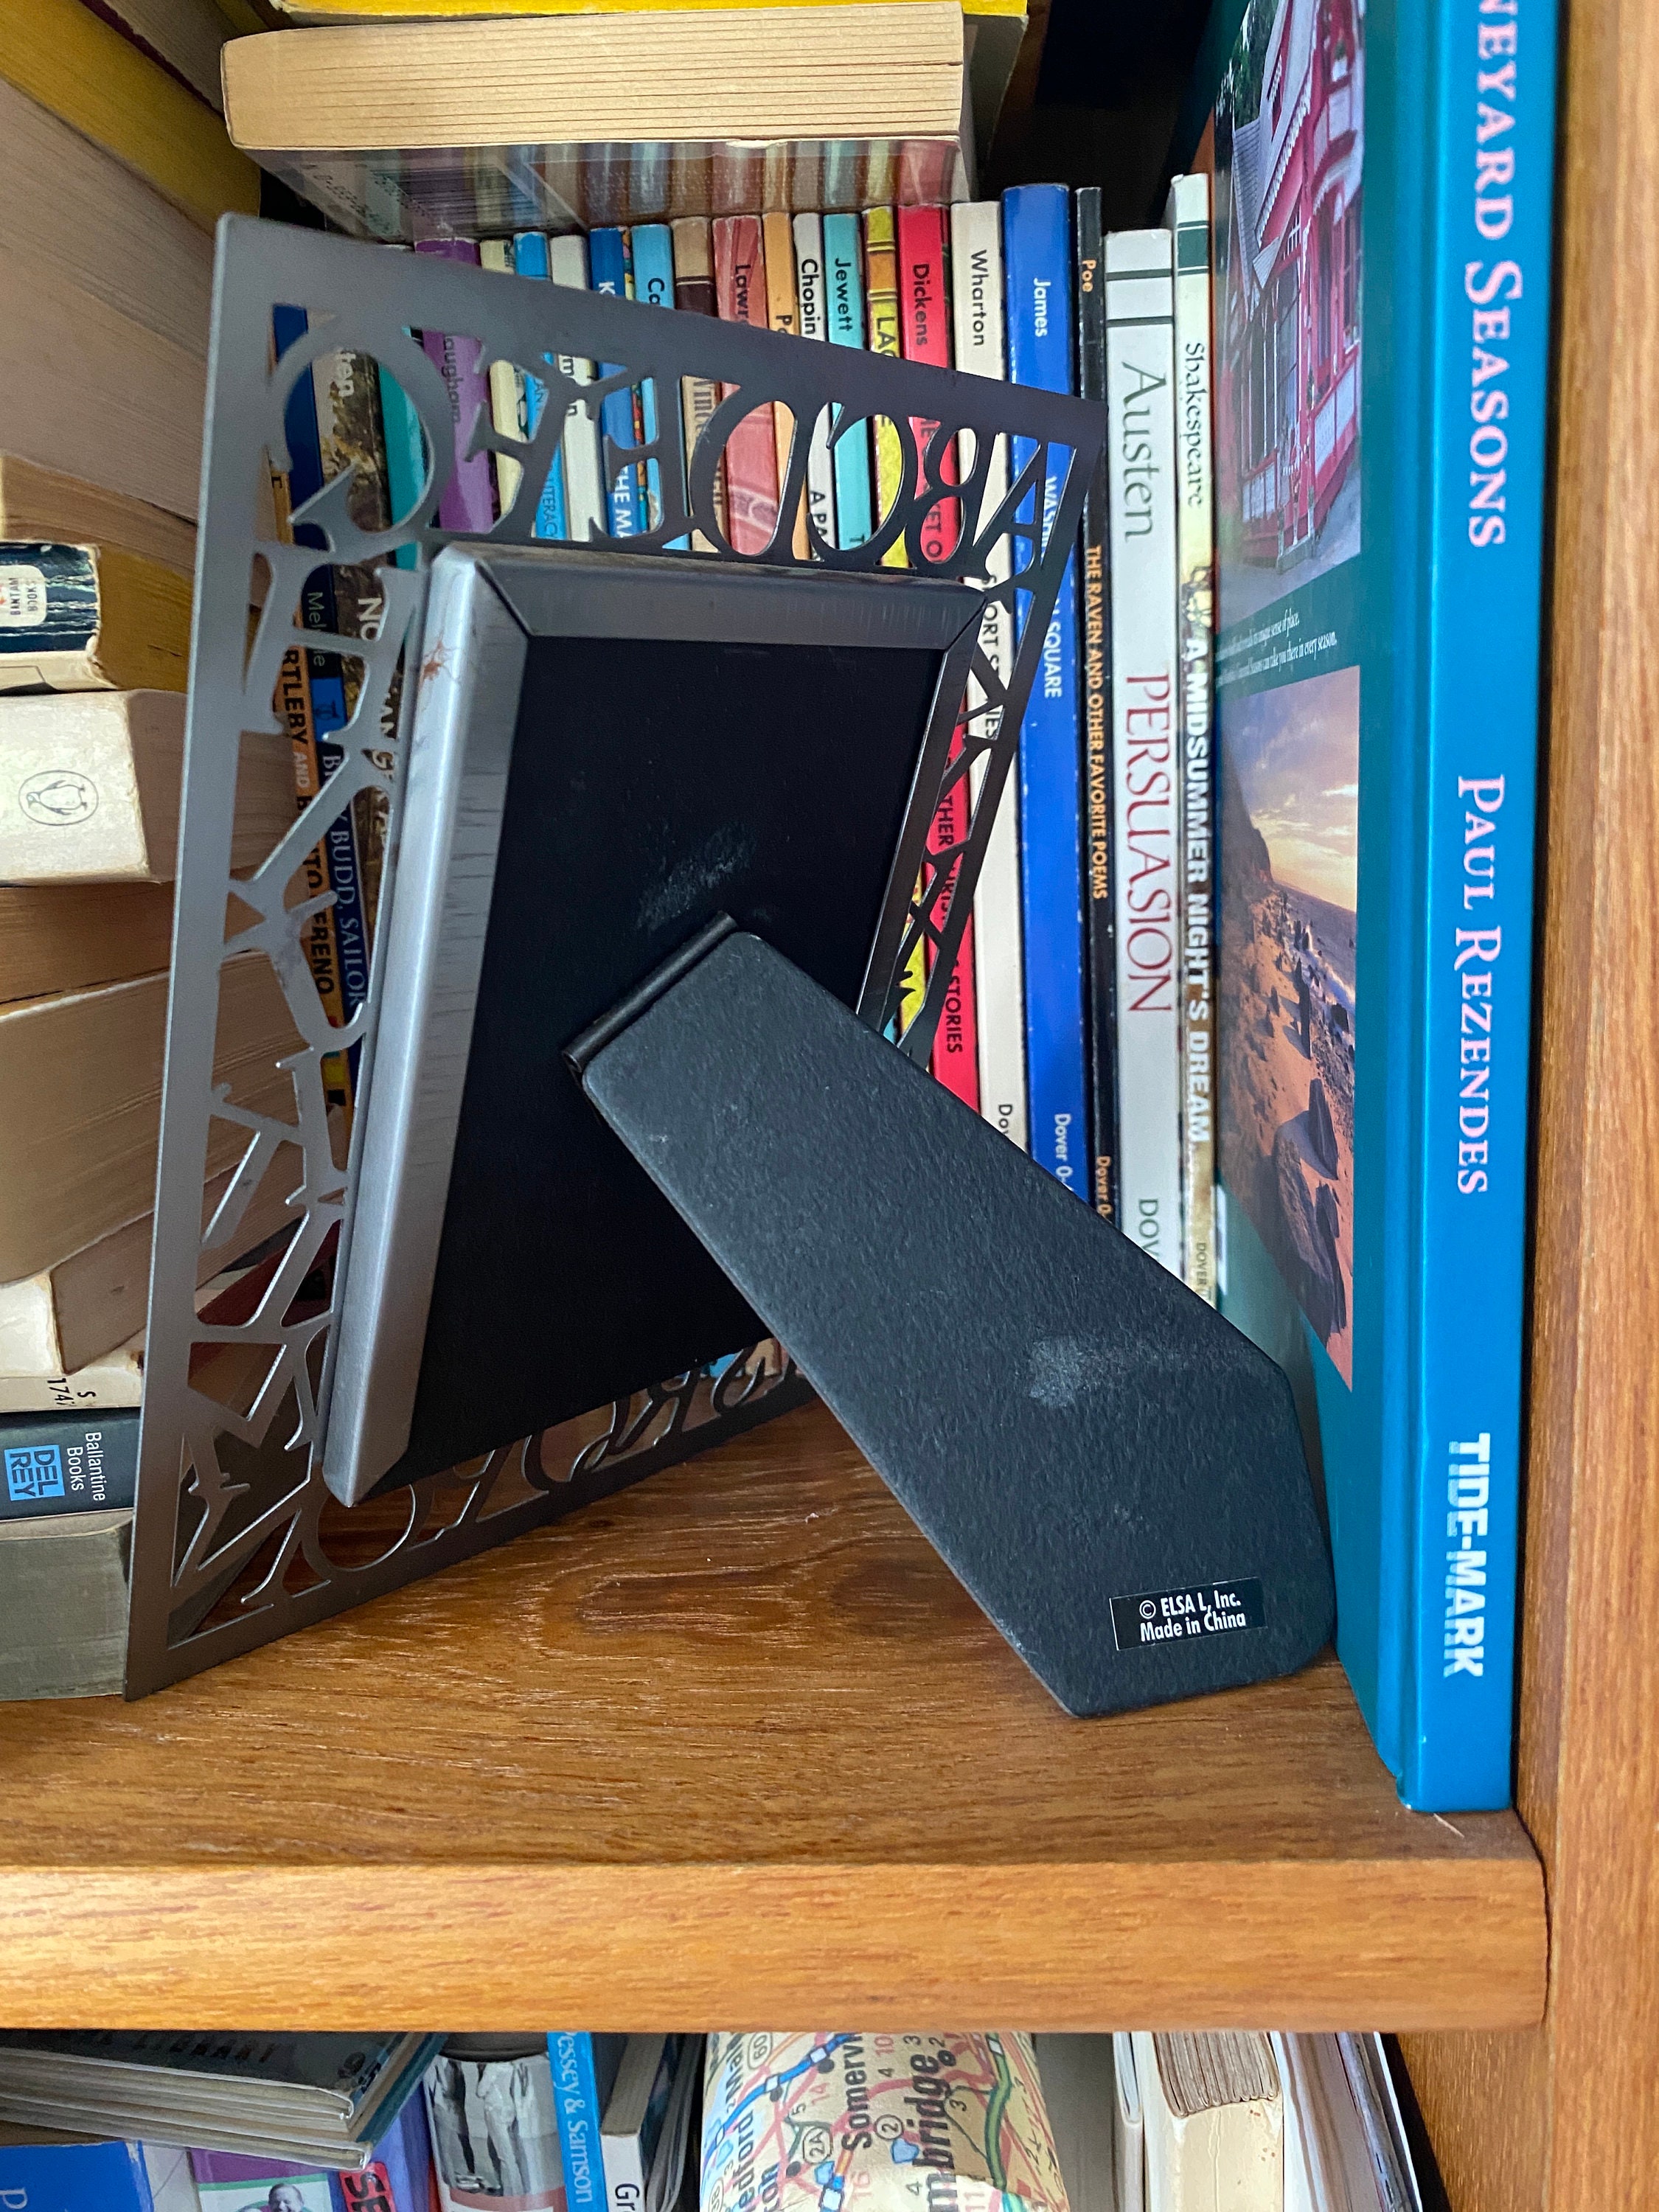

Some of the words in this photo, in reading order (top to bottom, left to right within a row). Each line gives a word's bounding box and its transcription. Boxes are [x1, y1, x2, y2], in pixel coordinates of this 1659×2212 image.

[801, 258, 820, 335] Chopin
[835, 258, 853, 332] Jewett
[912, 262, 932, 346] Dickens
[970, 249, 990, 347] Wharton
[1033, 277, 1051, 338] James
[1082, 259, 1097, 293] Poe
[442, 337, 464, 423] augham
[1464, 260, 1523, 549] SEASONS
[1121, 361, 1167, 543] Austen
[1180, 342, 1208, 509] Shakespeare
[1086, 545, 1103, 580] THE
[1086, 582, 1104, 644] RAVEN
[1318, 630, 1338, 651] season.
[1043, 621, 1062, 699] SQUARE
[1088, 649, 1104, 690] AND
[1186, 638, 1208, 662] A
[282, 648, 307, 745] RTLEBY
[1088, 695, 1105, 754] OTHER
[1089, 754, 1107, 838] FAVORITE
[1186, 672, 1210, 883] MIDSUMMER
[937, 796, 955, 847] THER
[1125, 673, 1173, 1012] PERSUASION
[1457, 774, 1506, 911] PAUL
[1092, 841, 1108, 900] POEMS
[339, 917, 368, 1006] SAILOR
[1184, 893, 1211, 1021] NIGHT'S
[1187, 1032, 1211, 1143] DREAM
[1454, 925, 1502, 1195] REZENDES
[998, 1103, 1013, 1135] Dov
[1054, 1113, 1072, 1162] Dover
[1095, 1155, 1112, 1201] Dover
[1138, 1198, 1160, 1259] DOV
[10, 1451, 36, 1498] REY
[33, 1449, 59, 1496] DEL
[66, 1446, 86, 1492] Books
[85, 1431, 108, 1501] Ballantine
[1443, 1432, 1492, 1678] TIDE-MARK
[1139, 1618, 1183, 1642] Made
[1185, 1616, 1201, 1635] in
[1203, 1610, 1247, 1632] China
[1160, 1593, 1196, 1618] ELSA
[1214, 1590, 1242, 1610] Inc.
[554, 2033, 581, 2096] essey
[567, 2120, 593, 2203] Samson
[732, 2110, 756, 2209] edford
